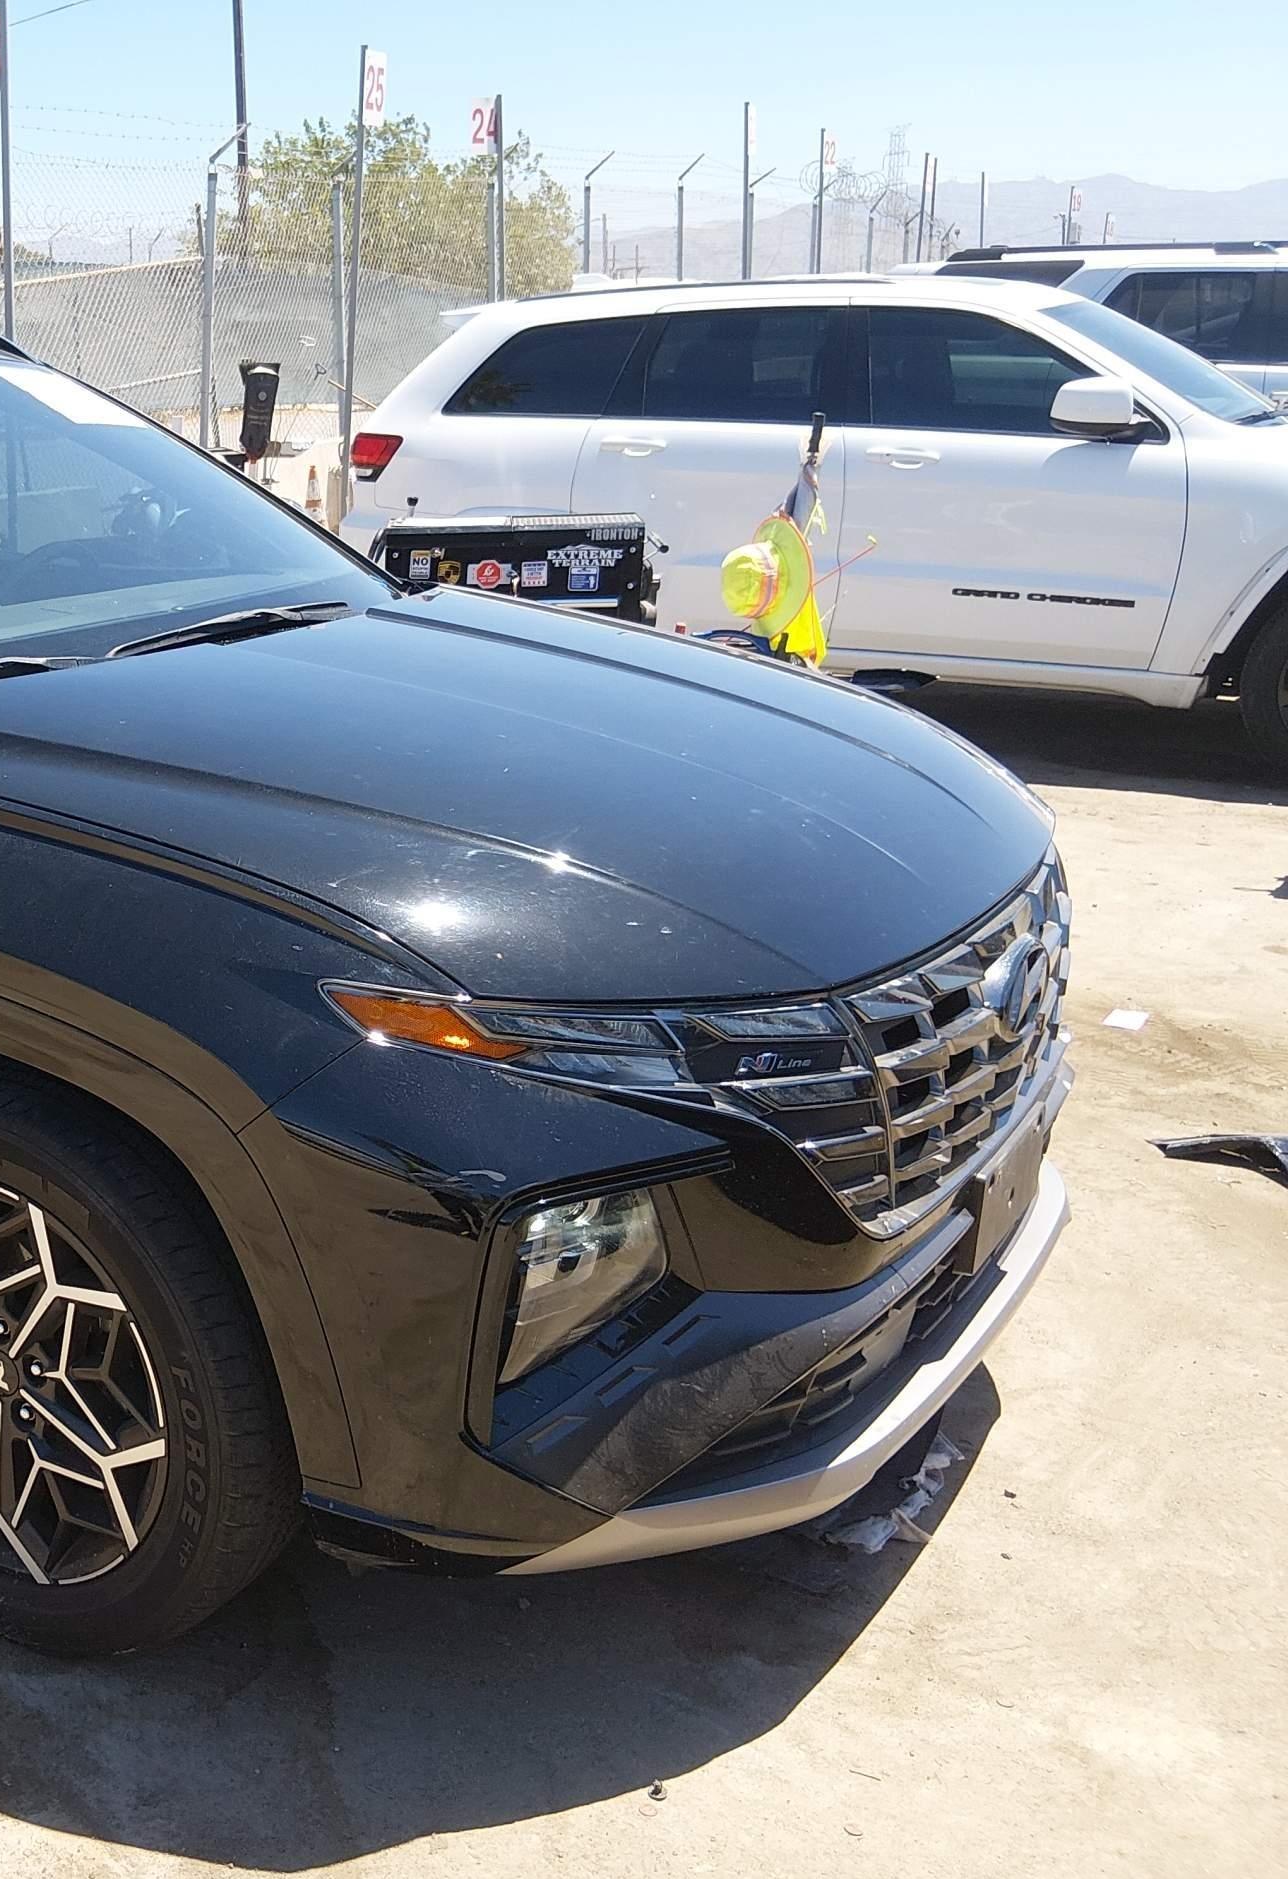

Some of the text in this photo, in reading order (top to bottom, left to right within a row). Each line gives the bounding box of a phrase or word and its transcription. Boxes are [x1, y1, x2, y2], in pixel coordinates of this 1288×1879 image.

[365, 65, 385, 112] 25
[472, 107, 497, 146] 24
[824, 140, 836, 166] 22
[547, 549, 623, 560] EXTREME
[412, 558, 429, 566] NO
[552, 559, 616, 568] TERRAIN
[952, 588, 1020, 600] GRAND
[777, 1058, 812, 1069] Line
[171, 1365, 207, 1535] FORCE
